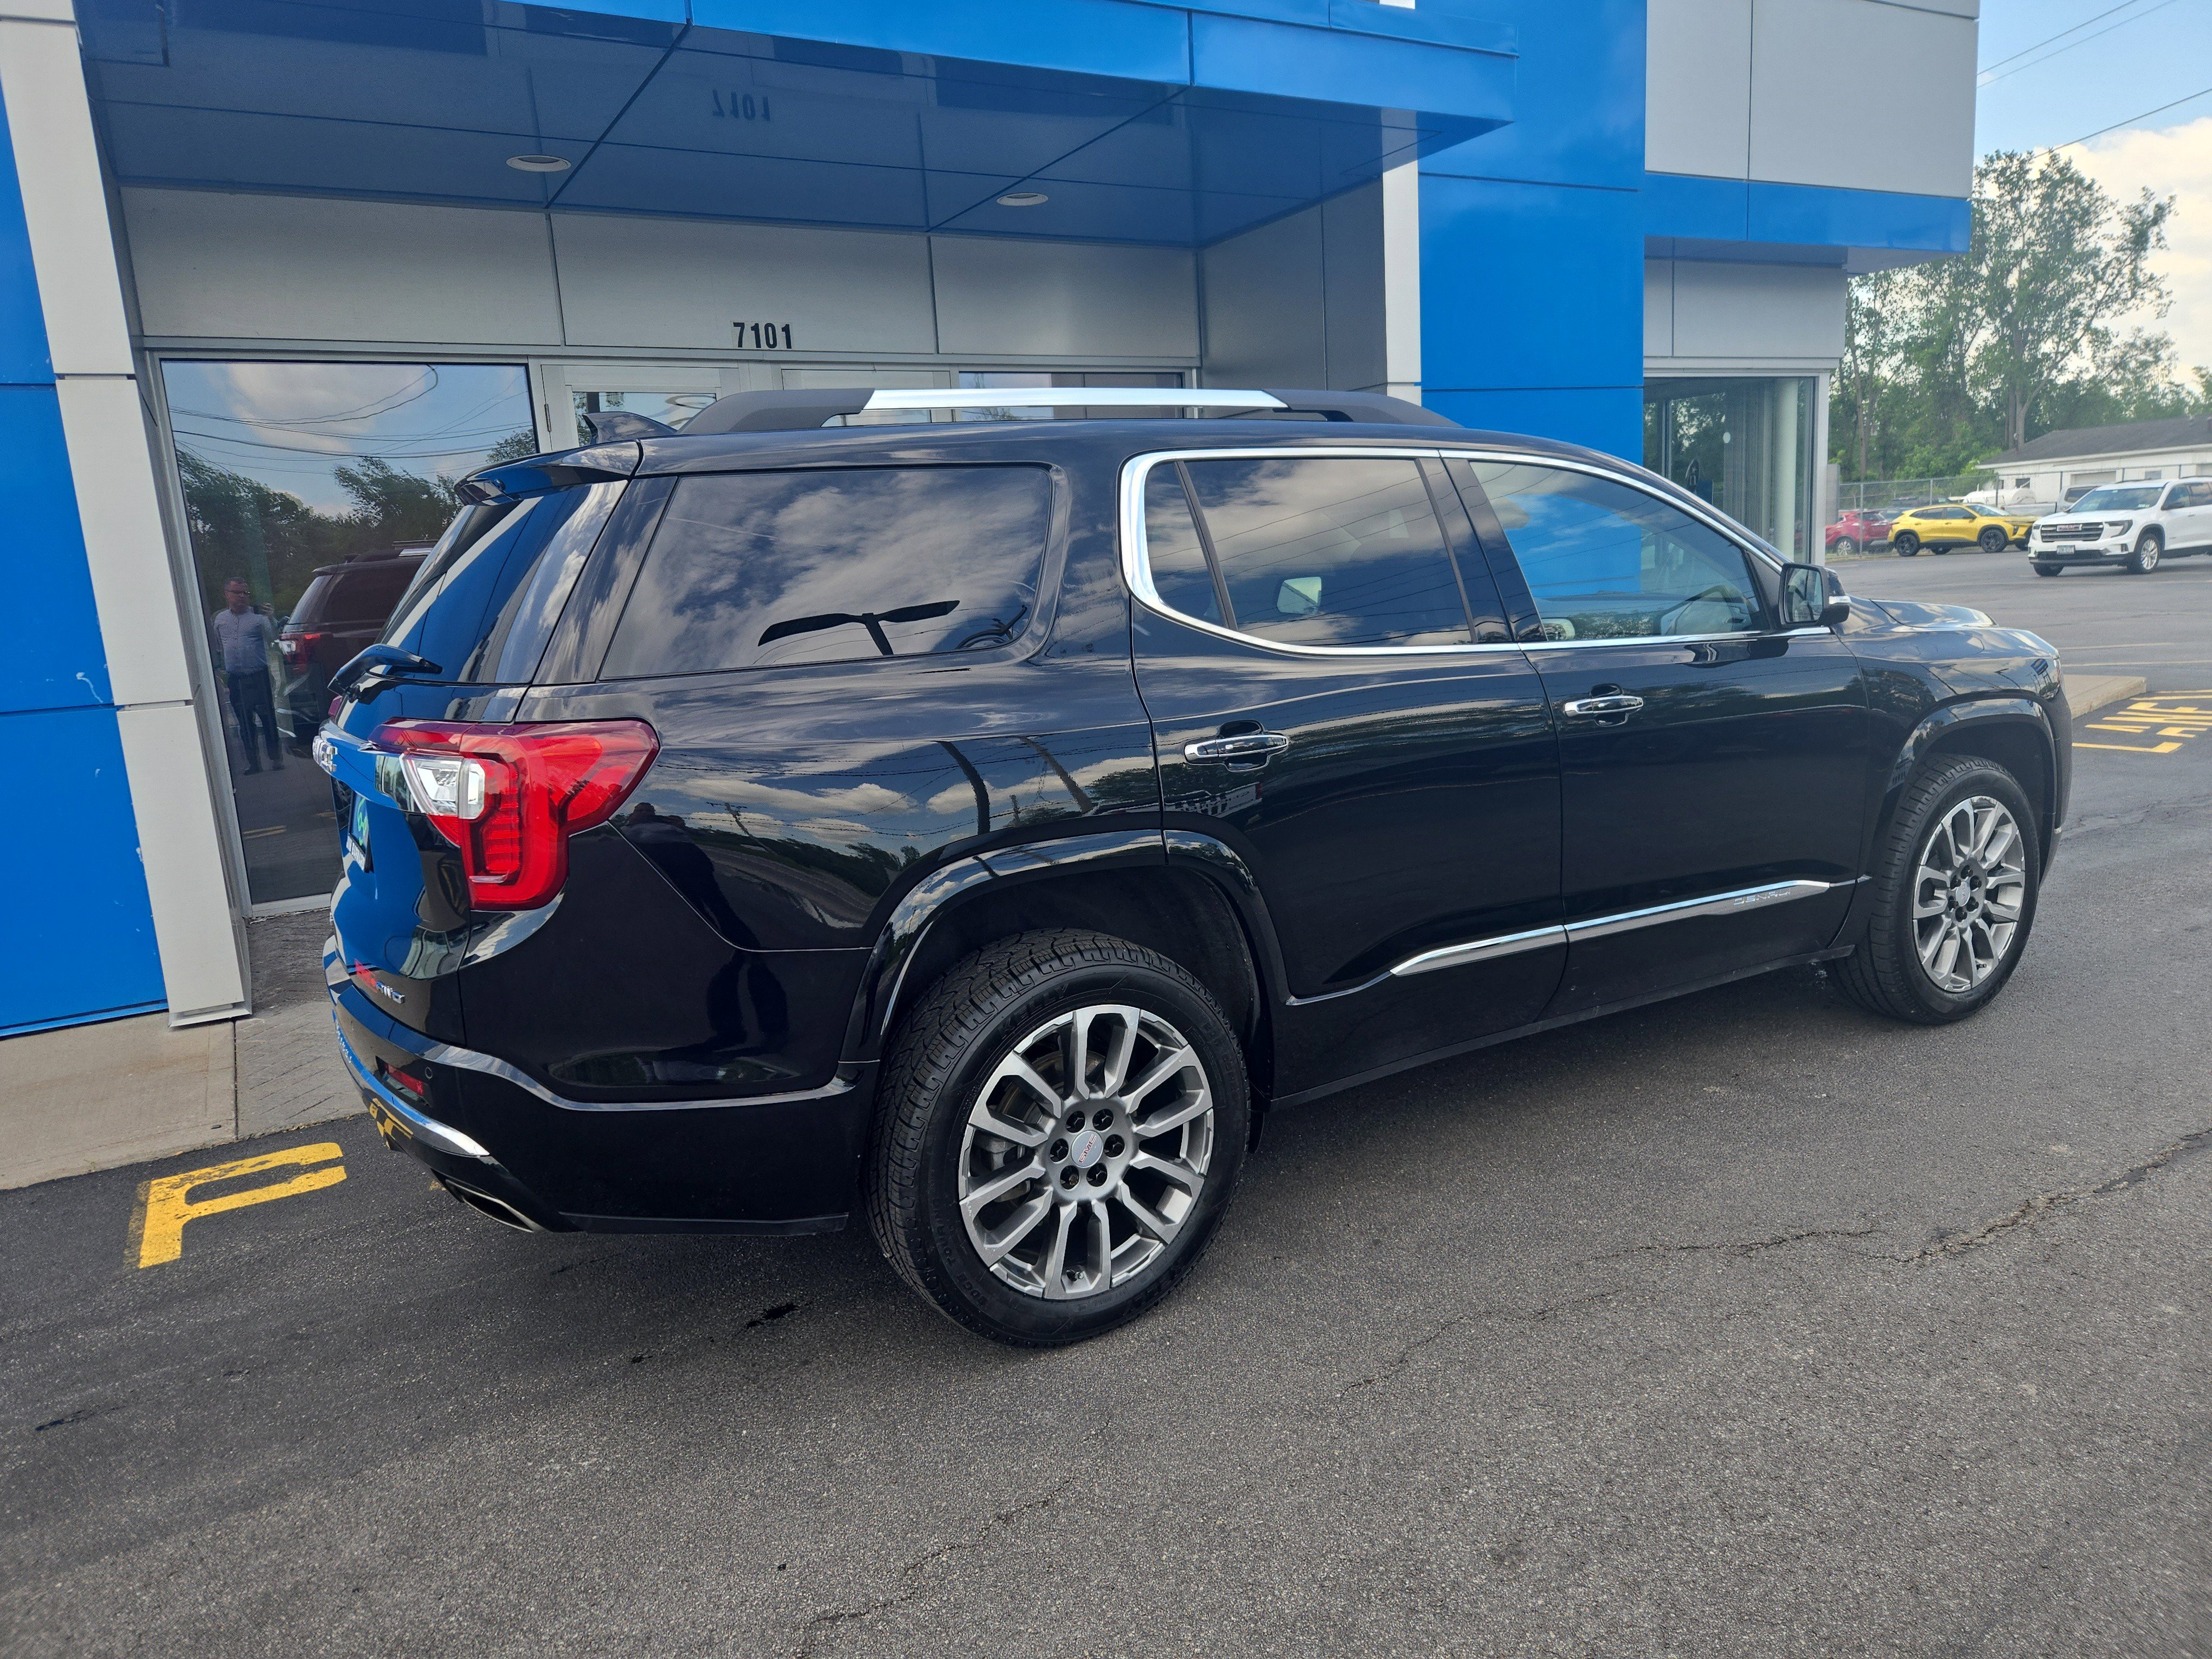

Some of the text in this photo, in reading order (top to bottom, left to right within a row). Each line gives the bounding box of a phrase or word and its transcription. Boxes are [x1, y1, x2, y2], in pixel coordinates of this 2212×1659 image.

[733, 323, 792, 349] 7101
[995, 981, 1070, 1040] KELLY
[1078, 1134, 1096, 1163] GMC
[957, 1270, 988, 1306] EDGE
